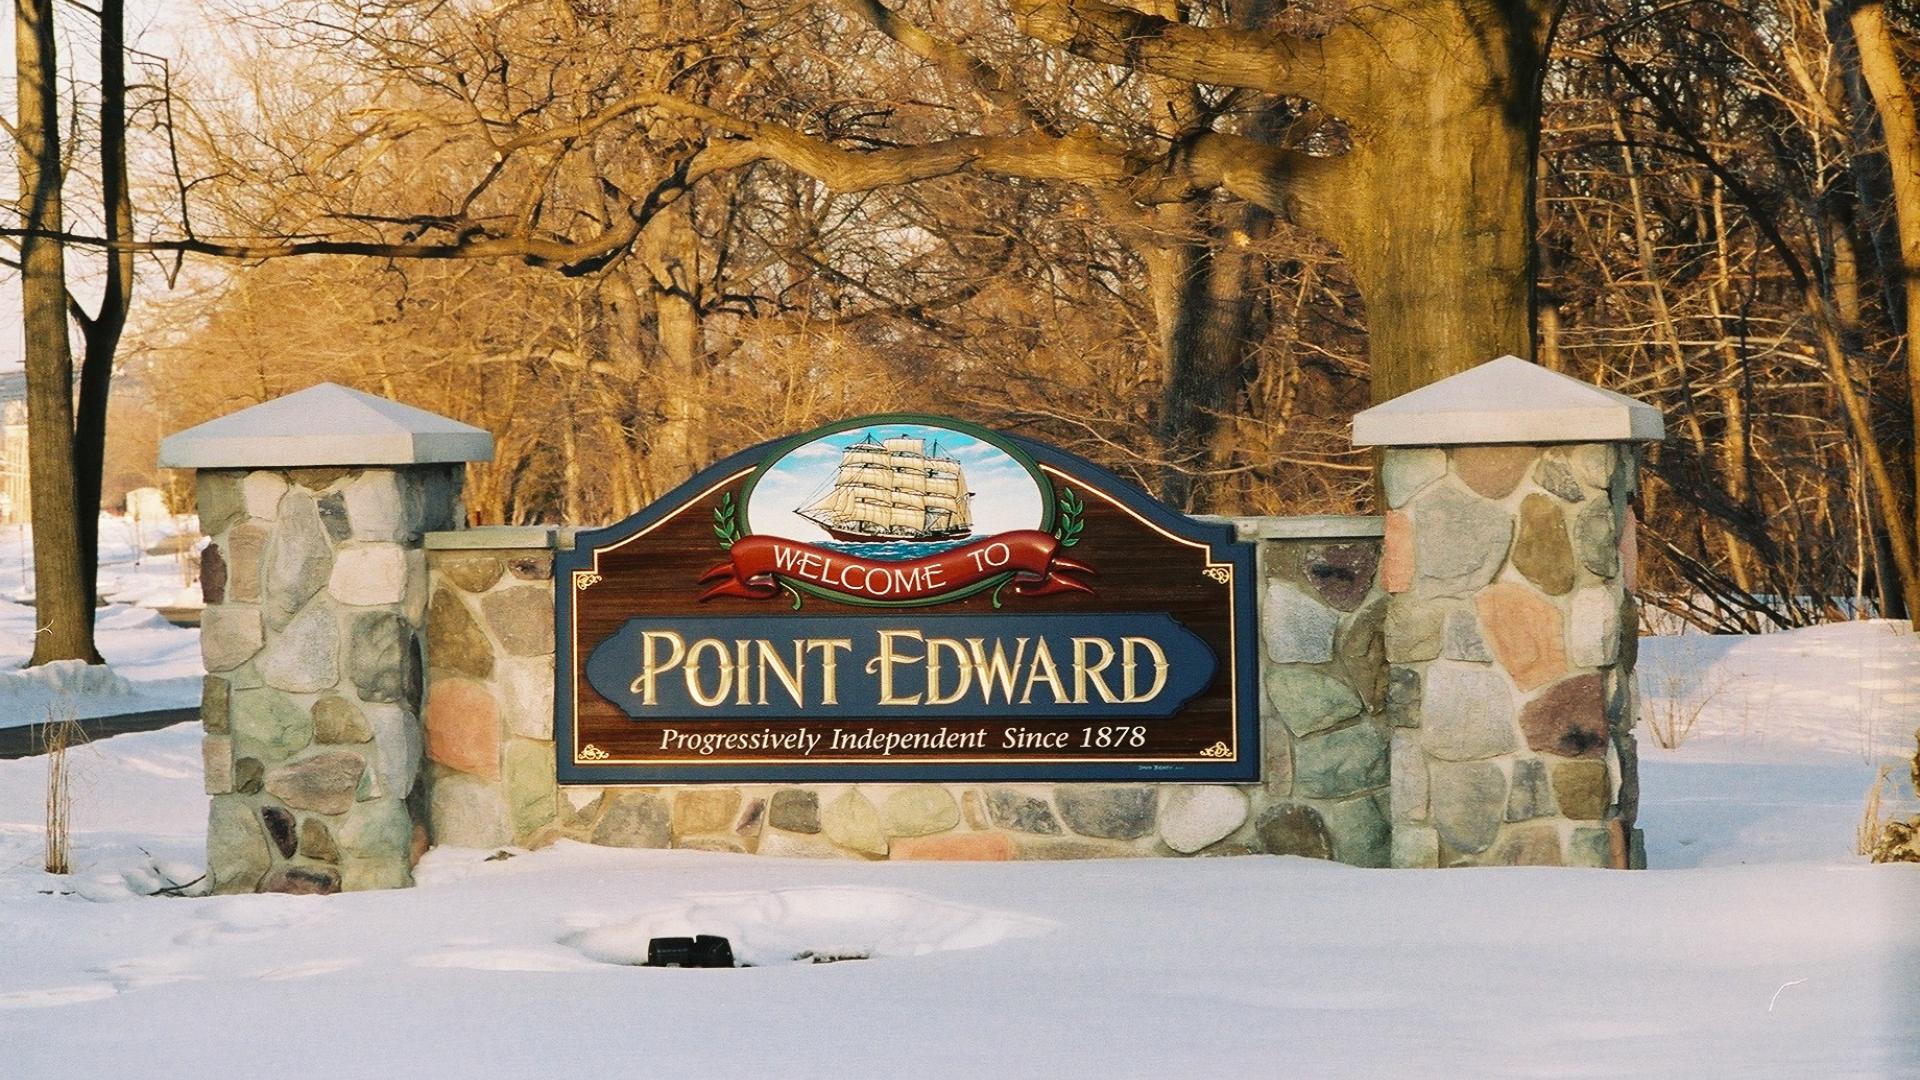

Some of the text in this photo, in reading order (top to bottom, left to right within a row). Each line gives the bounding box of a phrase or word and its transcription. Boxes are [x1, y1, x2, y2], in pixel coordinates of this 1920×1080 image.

[773, 542, 1011, 596] WELCOME TO
[630, 629, 1170, 709] POINT EDWARD
[659, 726, 1147, 756] Progressively Independent Since 1878
